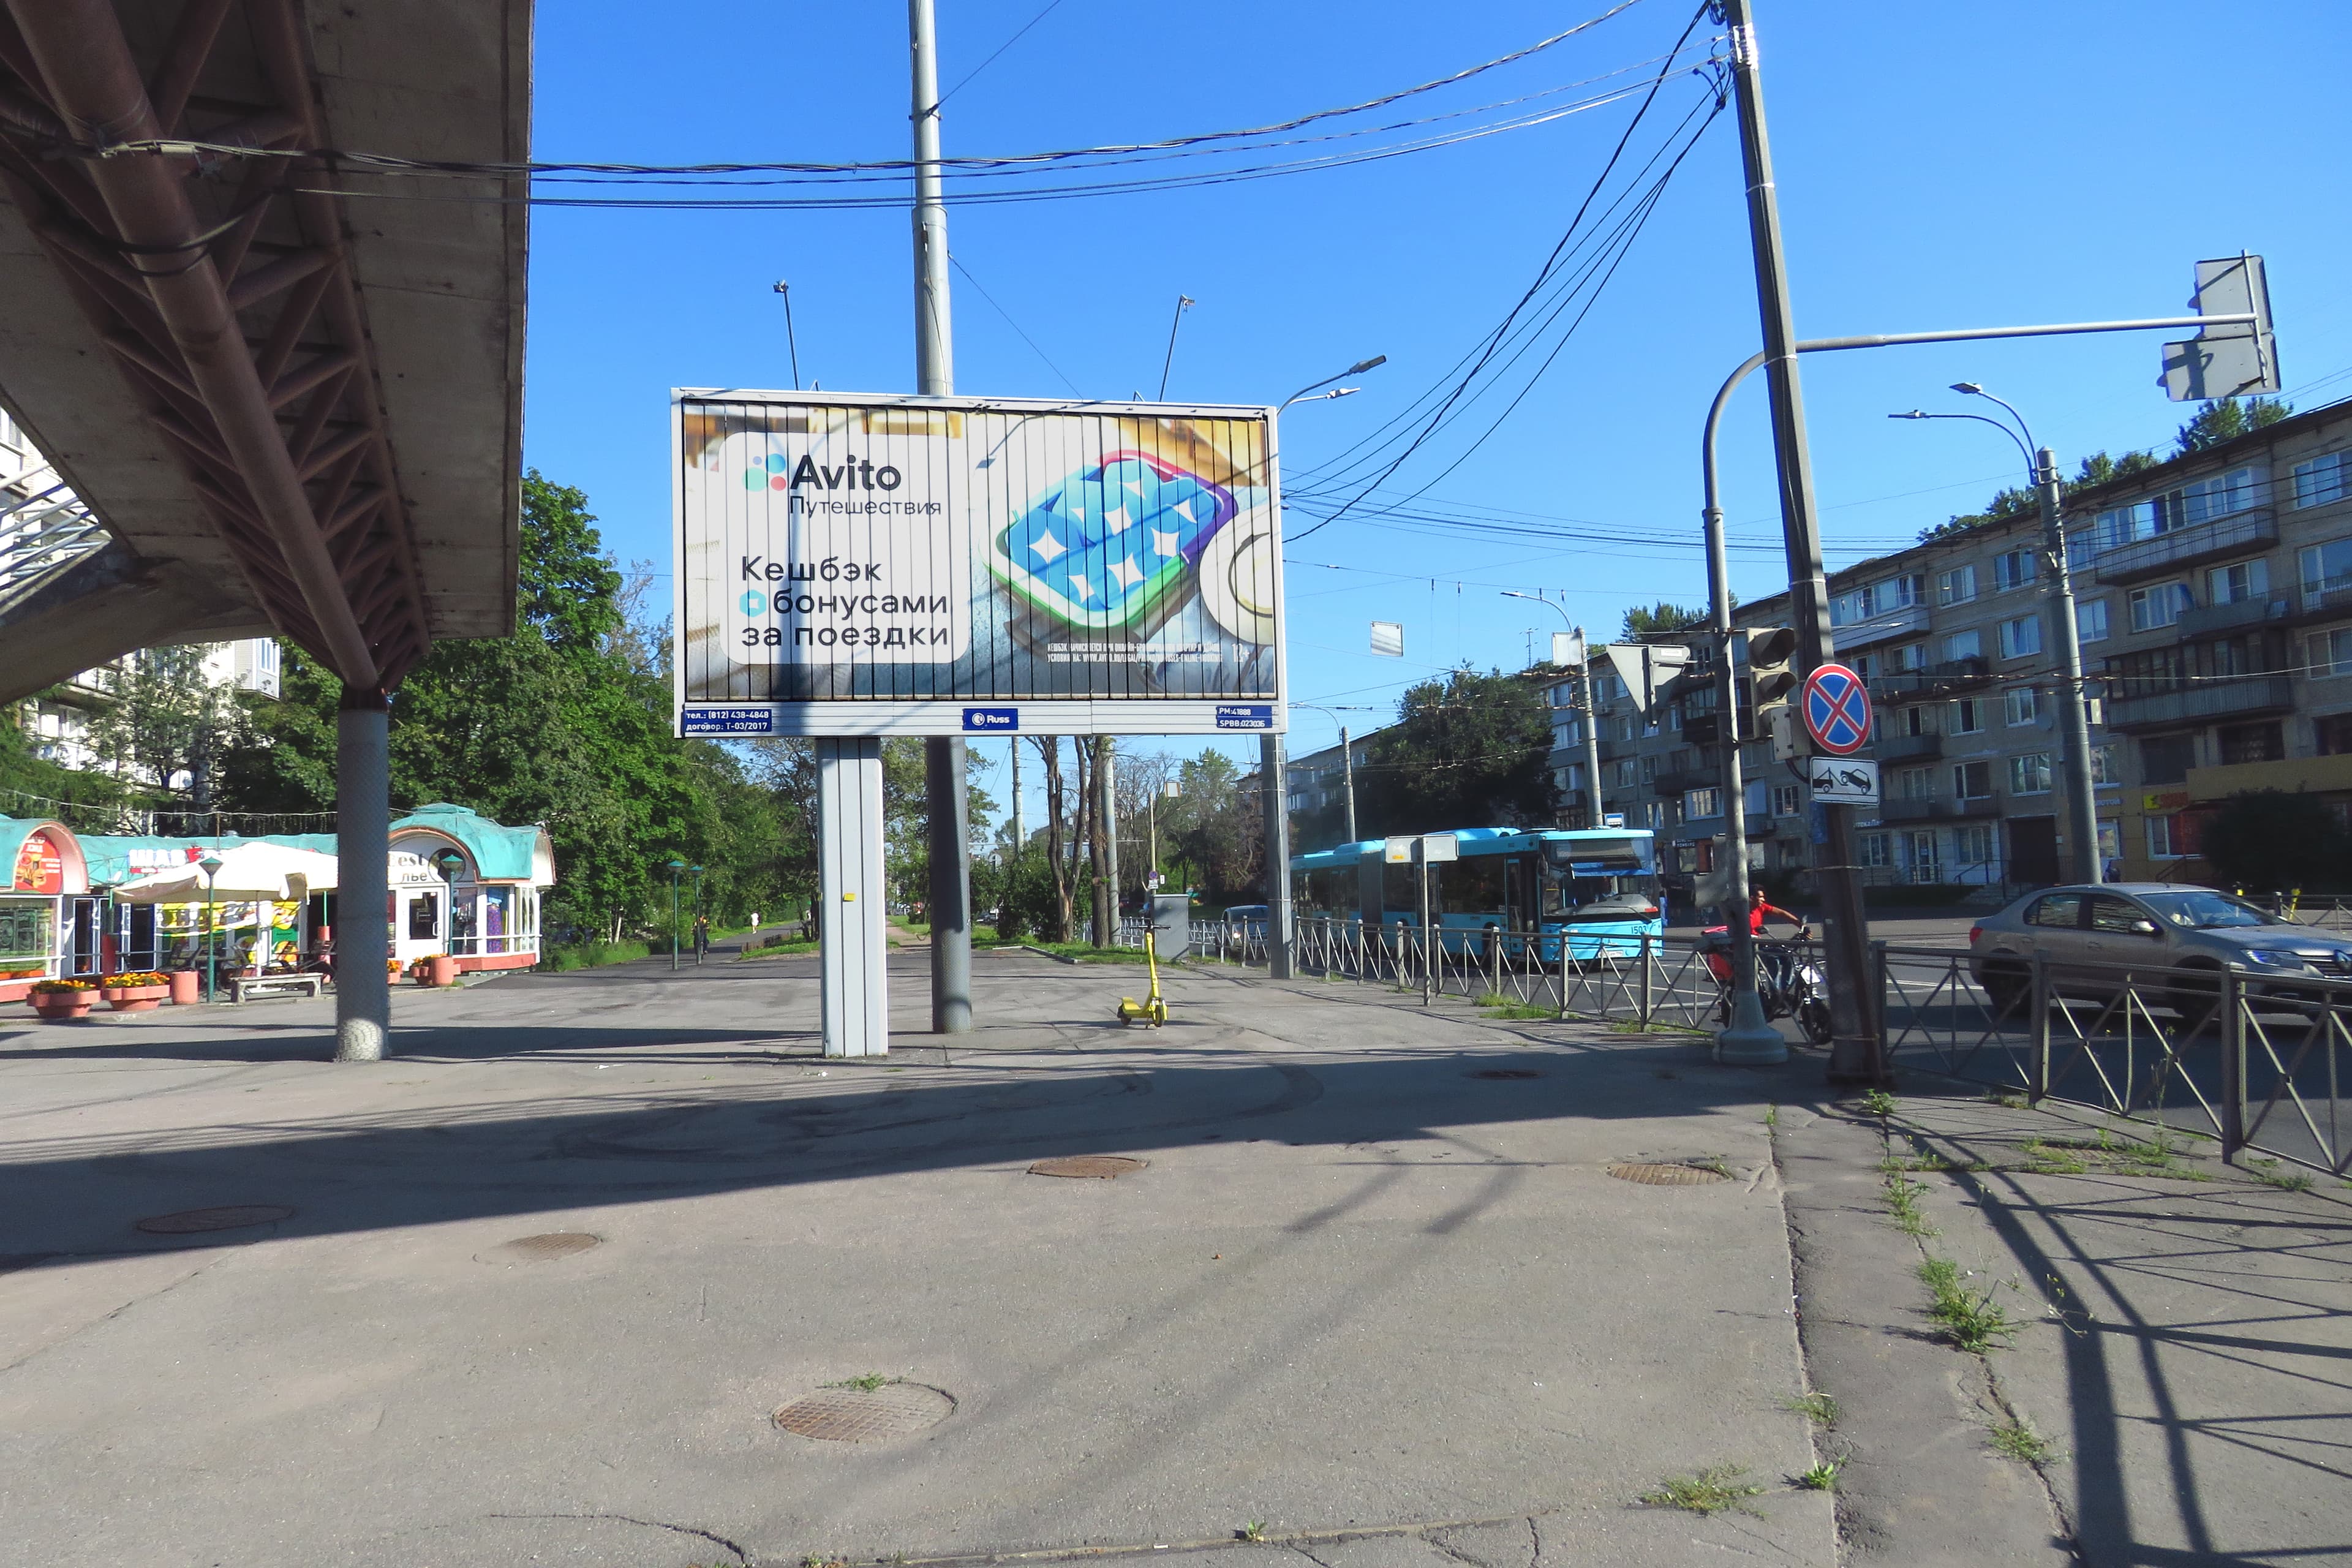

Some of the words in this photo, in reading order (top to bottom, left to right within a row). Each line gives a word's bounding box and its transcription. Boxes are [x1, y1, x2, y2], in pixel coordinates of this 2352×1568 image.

[790, 454, 902, 491] Avito
[790, 495, 941, 519] Путешествия
[742, 556, 882, 582] Кешбэк
[773, 588, 948, 620] бонусами
[741, 627, 782, 646] за
[794, 627, 948, 650] поездки
[1232, 643, 1250, 663] 12+
[708, 710, 729, 719] (812)
[987, 715, 1010, 723] Russ
[1631, 925, 1647, 935] 1503
